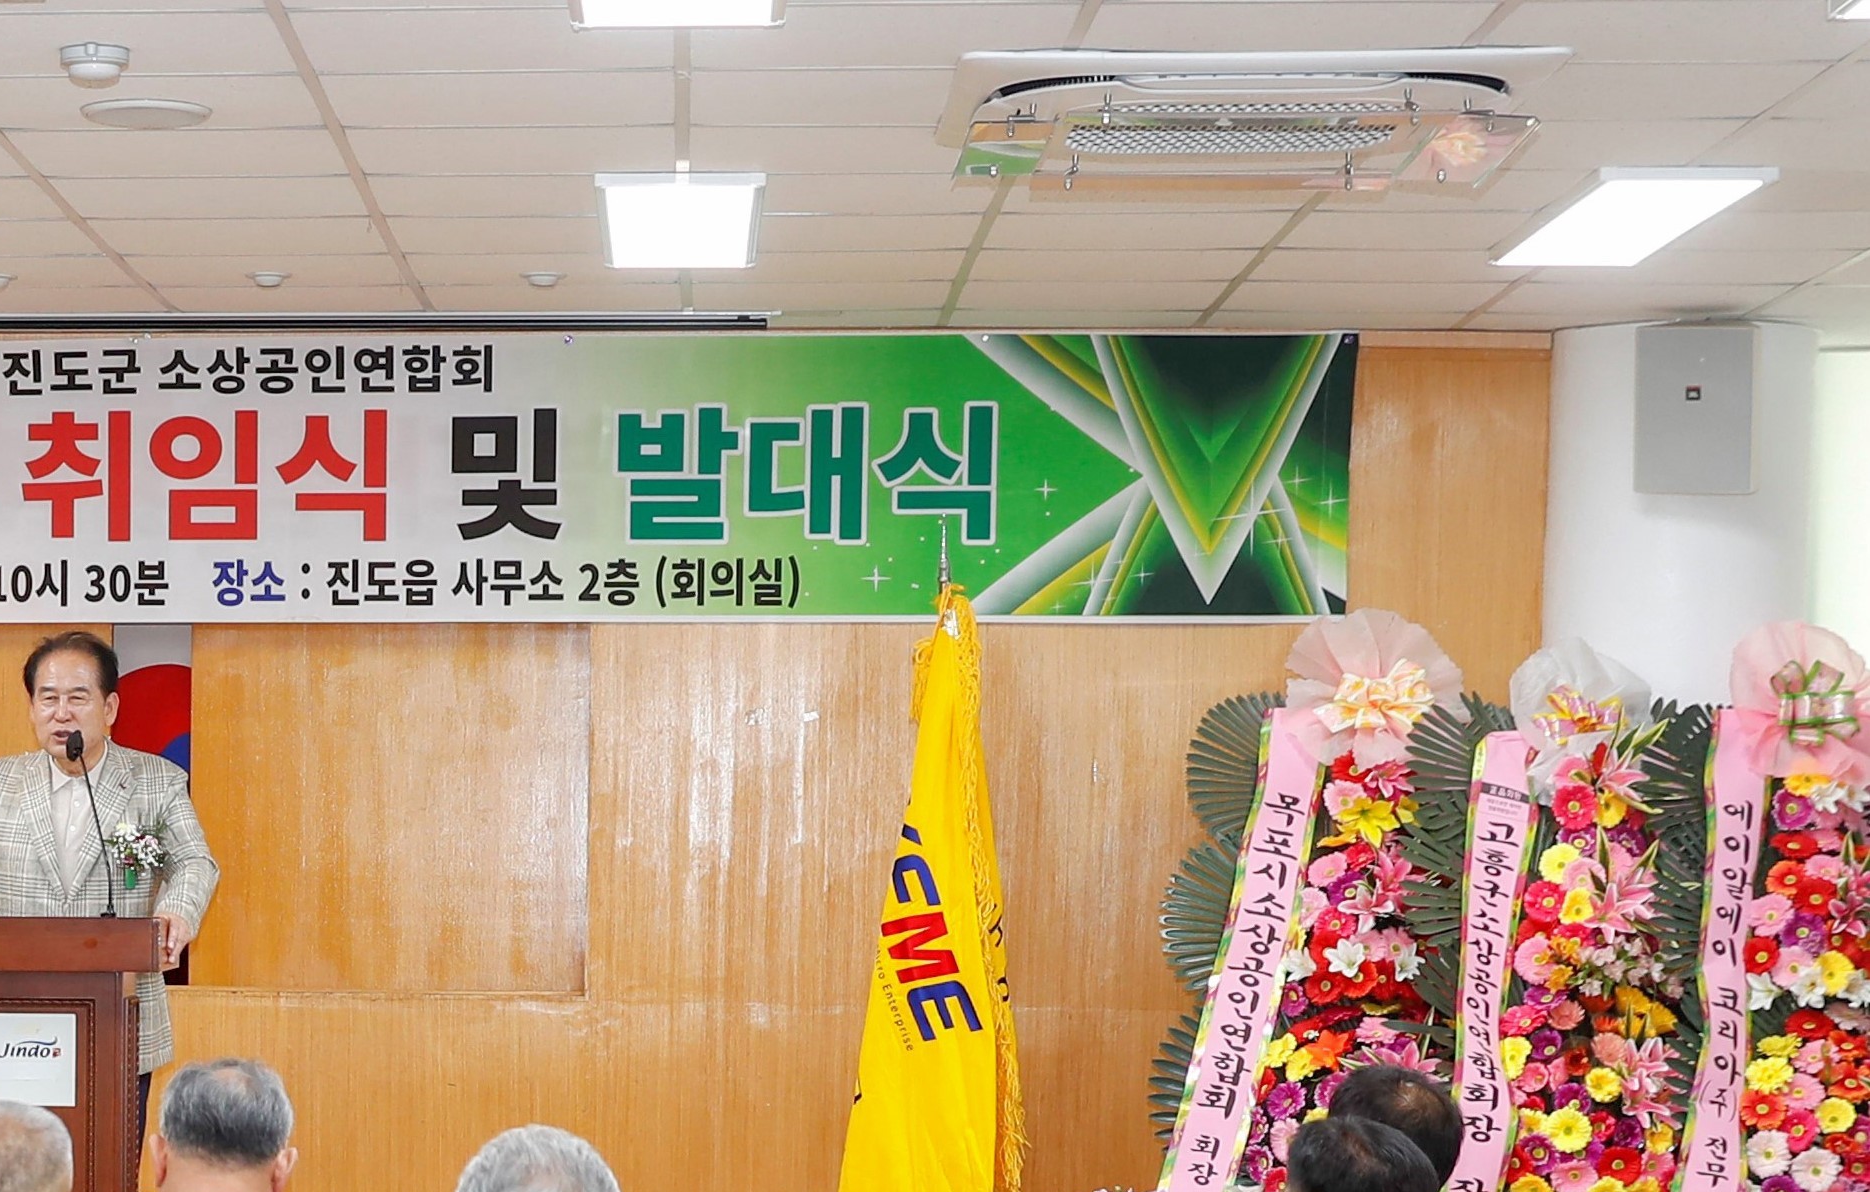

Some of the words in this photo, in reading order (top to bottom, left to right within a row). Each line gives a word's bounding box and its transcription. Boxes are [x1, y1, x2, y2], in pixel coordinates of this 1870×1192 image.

[2, 346, 142, 395] 진도군
[160, 346, 494, 394] 소상공인연합회
[21, 409, 387, 542] 취임식
[450, 408, 562, 541] 및
[618, 406, 992, 540] 발대식
[85, 559, 169, 605] 30분
[212, 560, 285, 606] 장소
[326, 560, 438, 606] 진도읍
[452, 559, 563, 606] 사무소
[579, 560, 639, 606] 2층
[656, 555, 800, 607] (회의실)
[882, 983, 915, 1052] Enterprise
